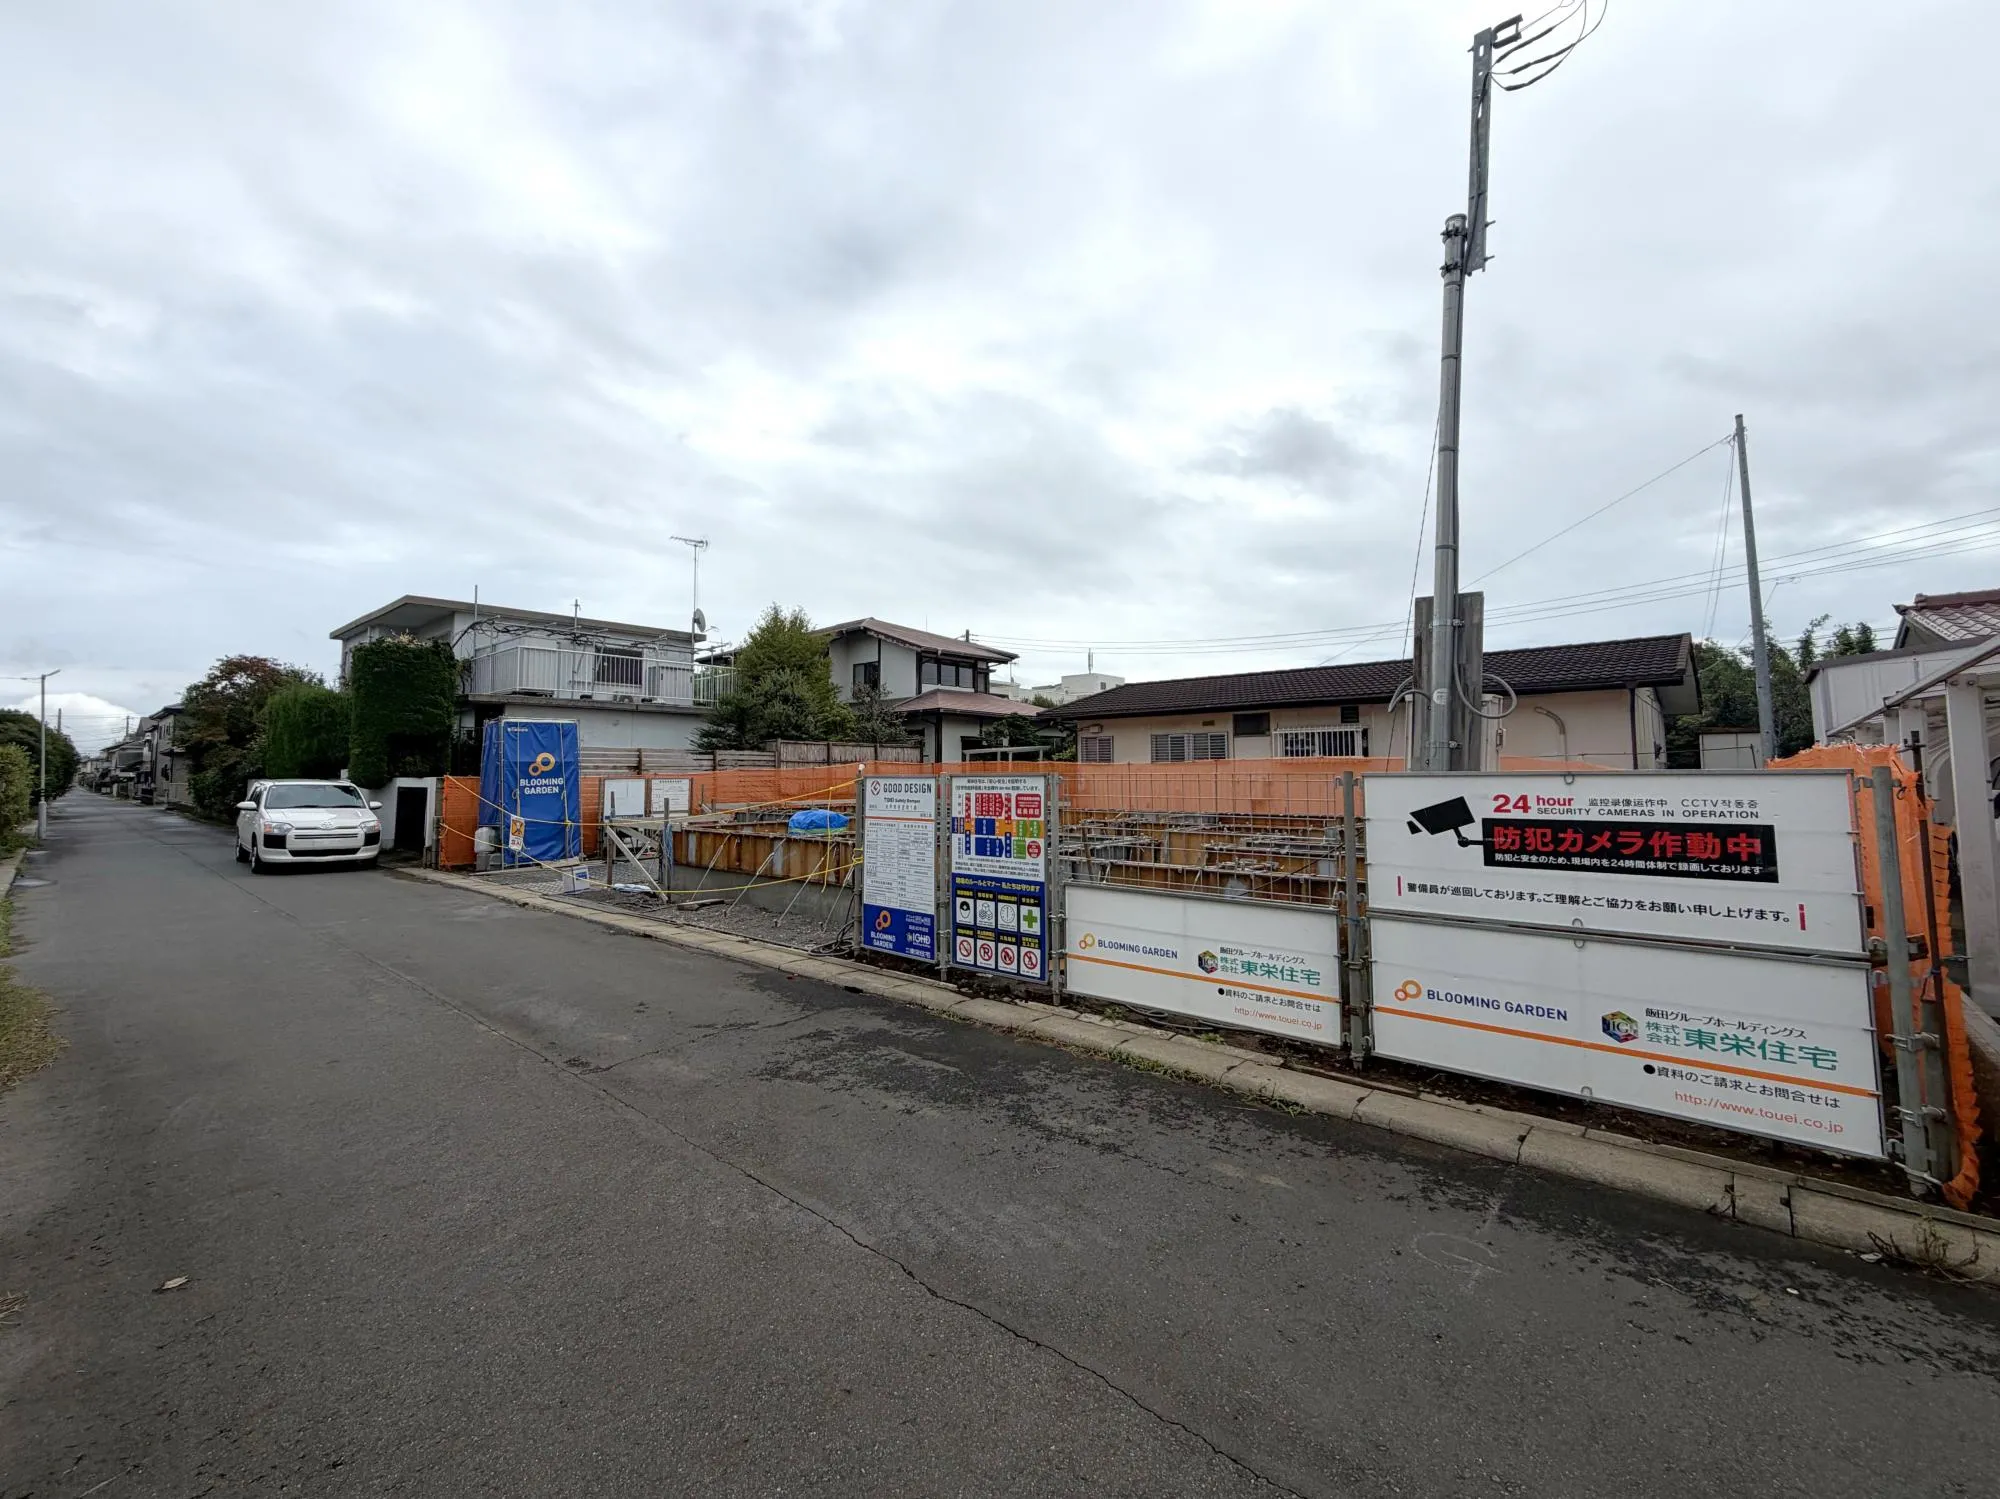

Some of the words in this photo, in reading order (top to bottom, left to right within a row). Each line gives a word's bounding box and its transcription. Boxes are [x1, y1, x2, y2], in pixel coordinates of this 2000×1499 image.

[520, 778, 564, 787] BLOOMING
[524, 786, 559, 795] GARDEN
[883, 783, 903, 793] GOOD
[904, 784, 932, 794] DESIGN
[1492, 794, 1532, 814] 24
[1536, 795, 1575, 807] hour
[1537, 808, 1591, 816] SECURITY
[1598, 808, 1656, 817] CAMERAS
[1662, 809, 1675, 817] IN
[1682, 810, 1760, 819] OPERATION
[1493, 826, 1762, 862] 防犯カメラ作動中
[870, 931, 897, 942] BLOOMING
[1097, 939, 1141, 953] BLOOMING
[1142, 945, 1178, 960] GARDEN
[1239, 960, 1321, 986] 東栄住宅
[1427, 989, 1501, 1010] BLOOMING
[1504, 1001, 1568, 1022] GARDEN
[1645, 1007, 1808, 1040] 飯田グループホールディングス
[1645, 1021, 1680, 1035] 株式
[1646, 1032, 1681, 1047] 会社
[1682, 1027, 1839, 1072] 東栄住宅
[1674, 1091, 1845, 1135] http://www.touei.co.jp
